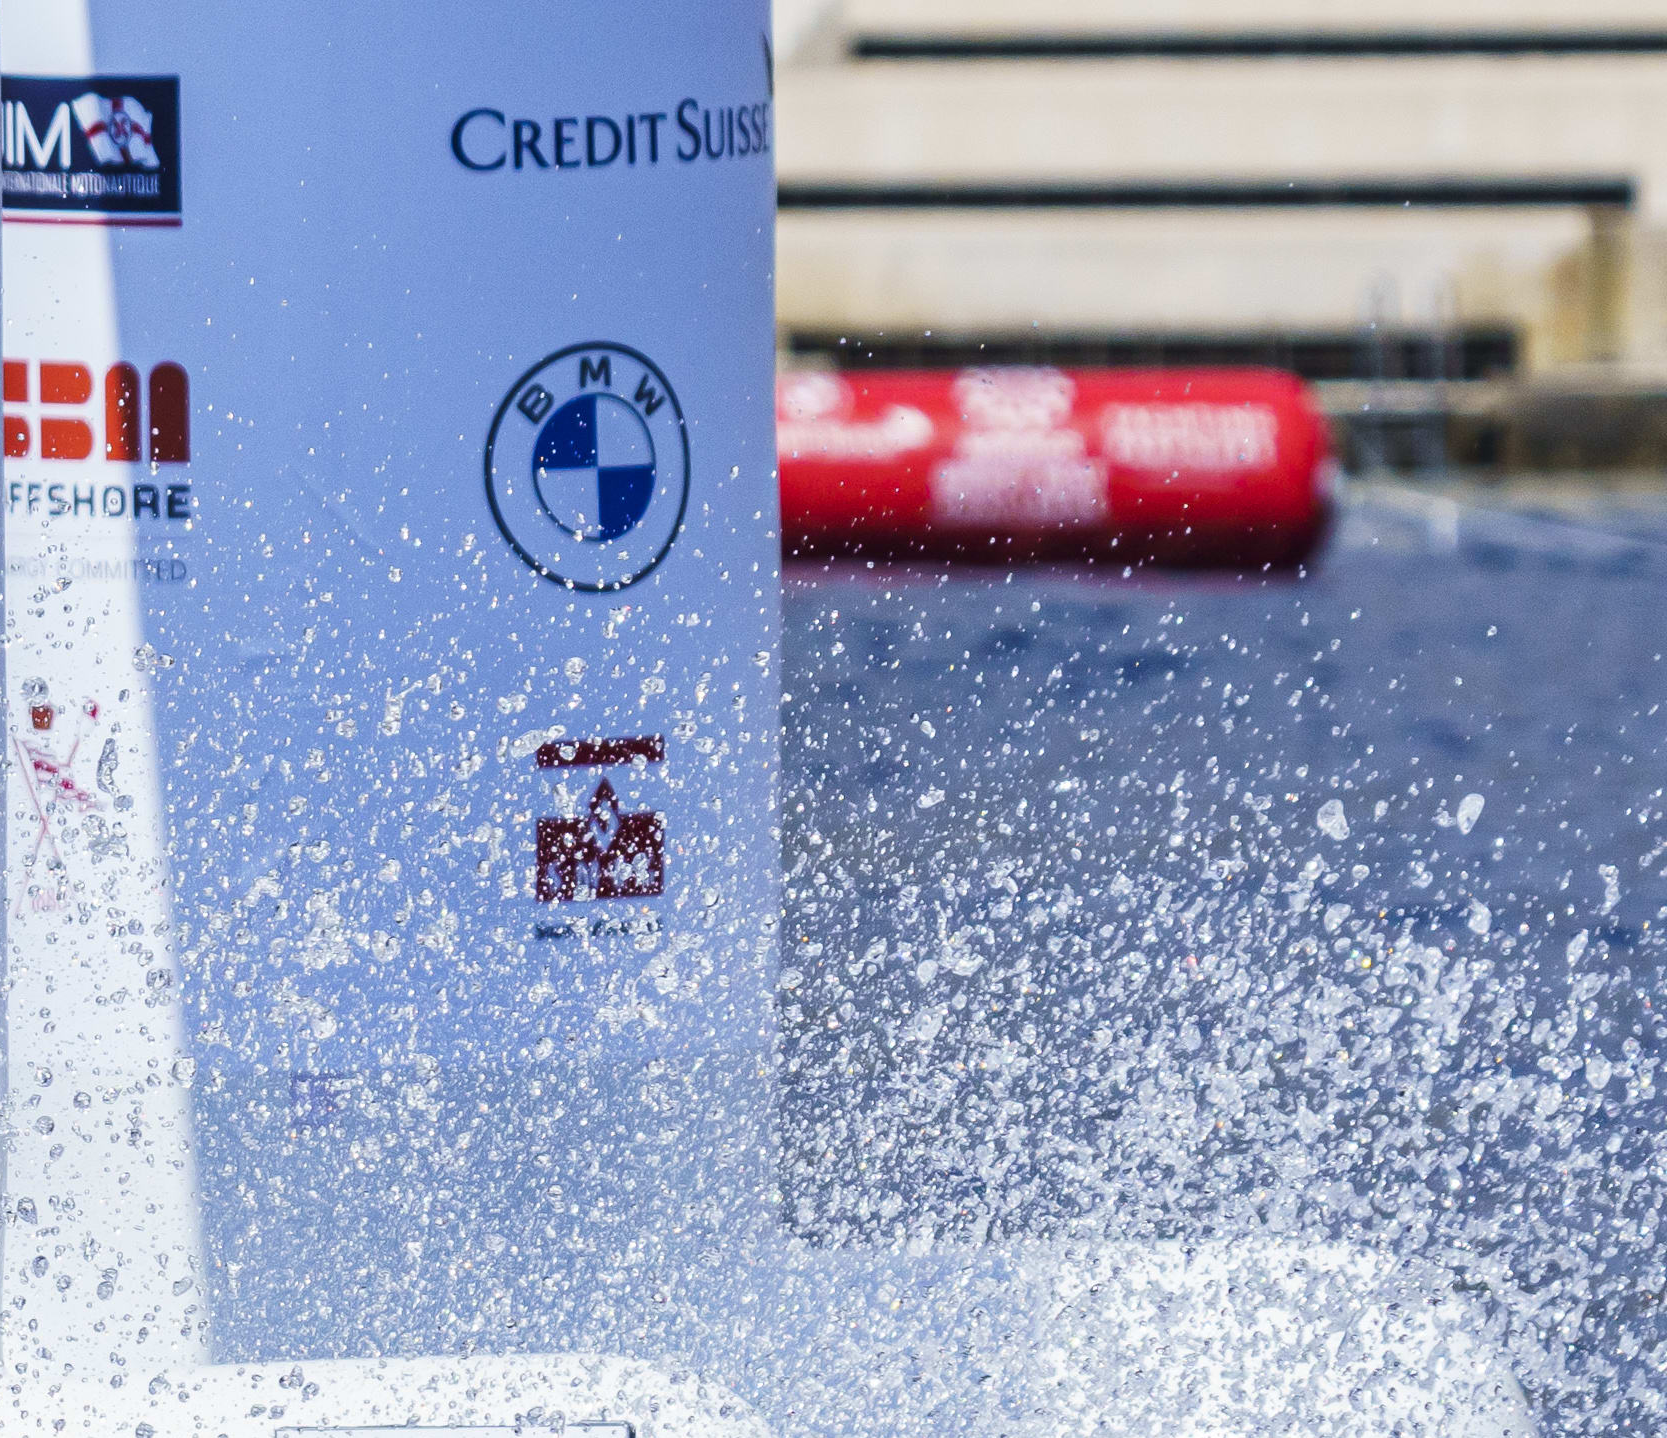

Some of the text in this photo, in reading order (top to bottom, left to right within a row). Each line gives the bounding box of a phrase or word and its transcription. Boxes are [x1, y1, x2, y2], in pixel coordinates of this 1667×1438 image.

[2, 100, 71, 169] IM
[451, 106, 667, 172] CREDIT
[518, 356, 665, 425] BMW
[7, 483, 192, 519] FFSHORE
